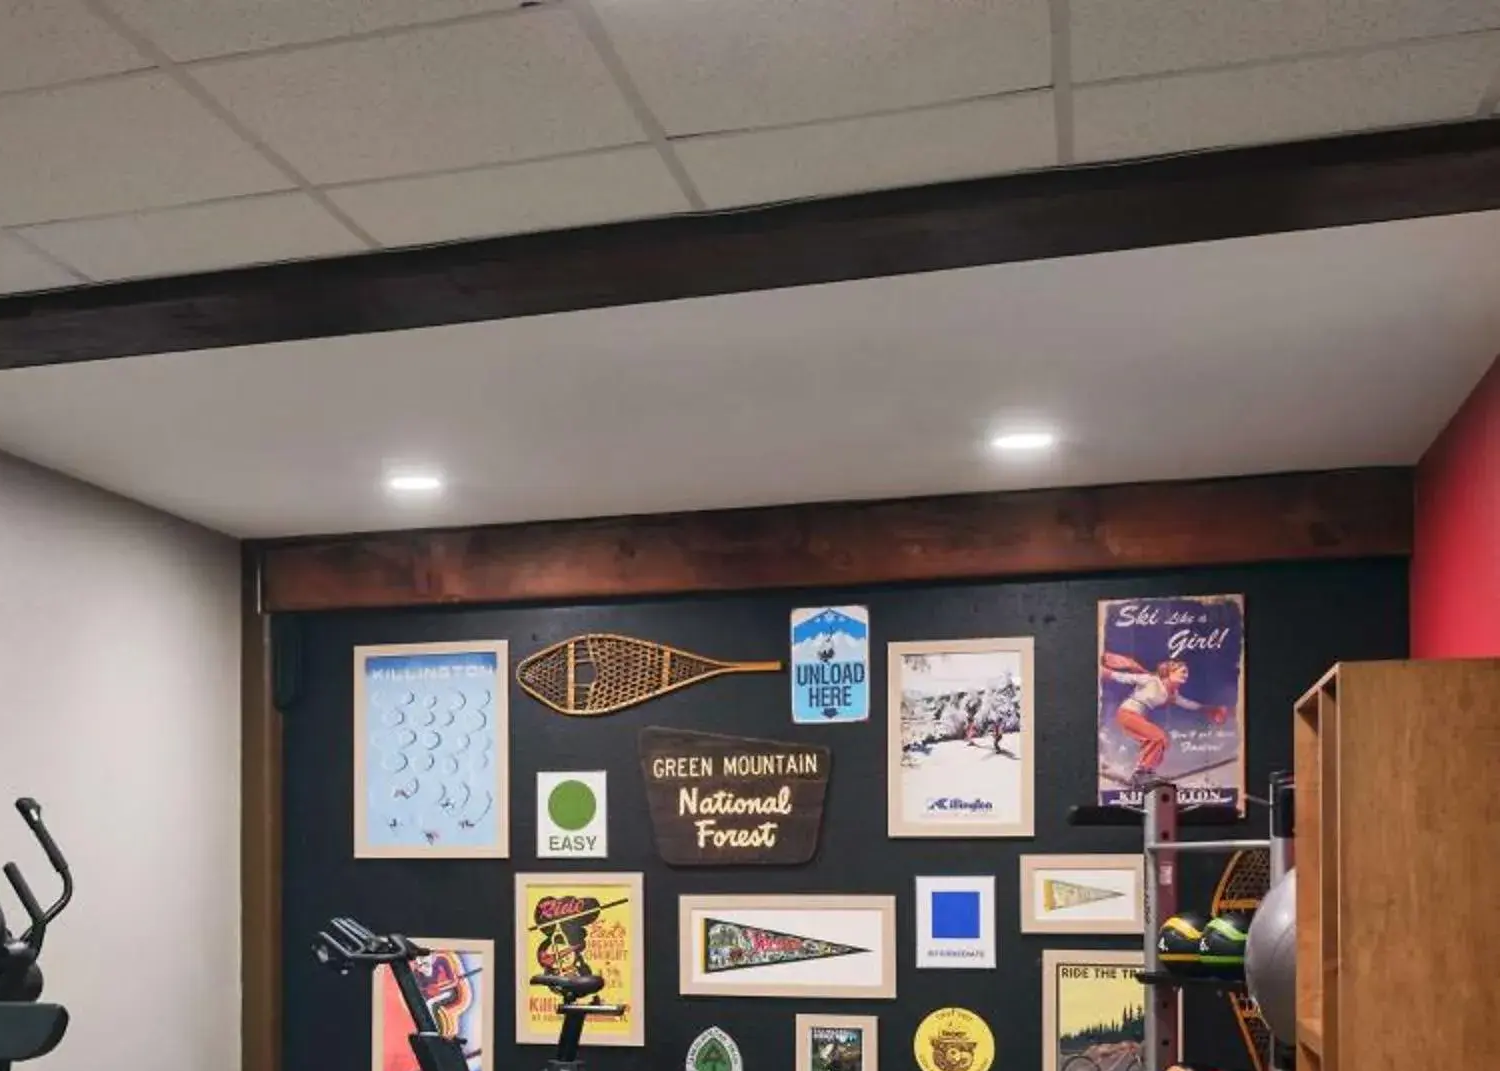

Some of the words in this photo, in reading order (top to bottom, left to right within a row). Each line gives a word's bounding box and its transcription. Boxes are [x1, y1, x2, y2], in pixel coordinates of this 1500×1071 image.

[1115, 605, 1159, 627] Ski
[1168, 628, 1229, 659] Girl!
[372, 664, 493, 681] KILLINGTON
[797, 663, 865, 686] UNLOAD
[808, 686, 852, 707] HERE
[653, 757, 713, 778] GREEN
[723, 753, 817, 776] MOUNTAIN
[679, 786, 792, 816] National
[549, 835, 597, 851] EASY
[694, 819, 778, 848] Forest
[1061, 967, 1089, 979] RIDE
[1094, 967, 1117, 979] THE
